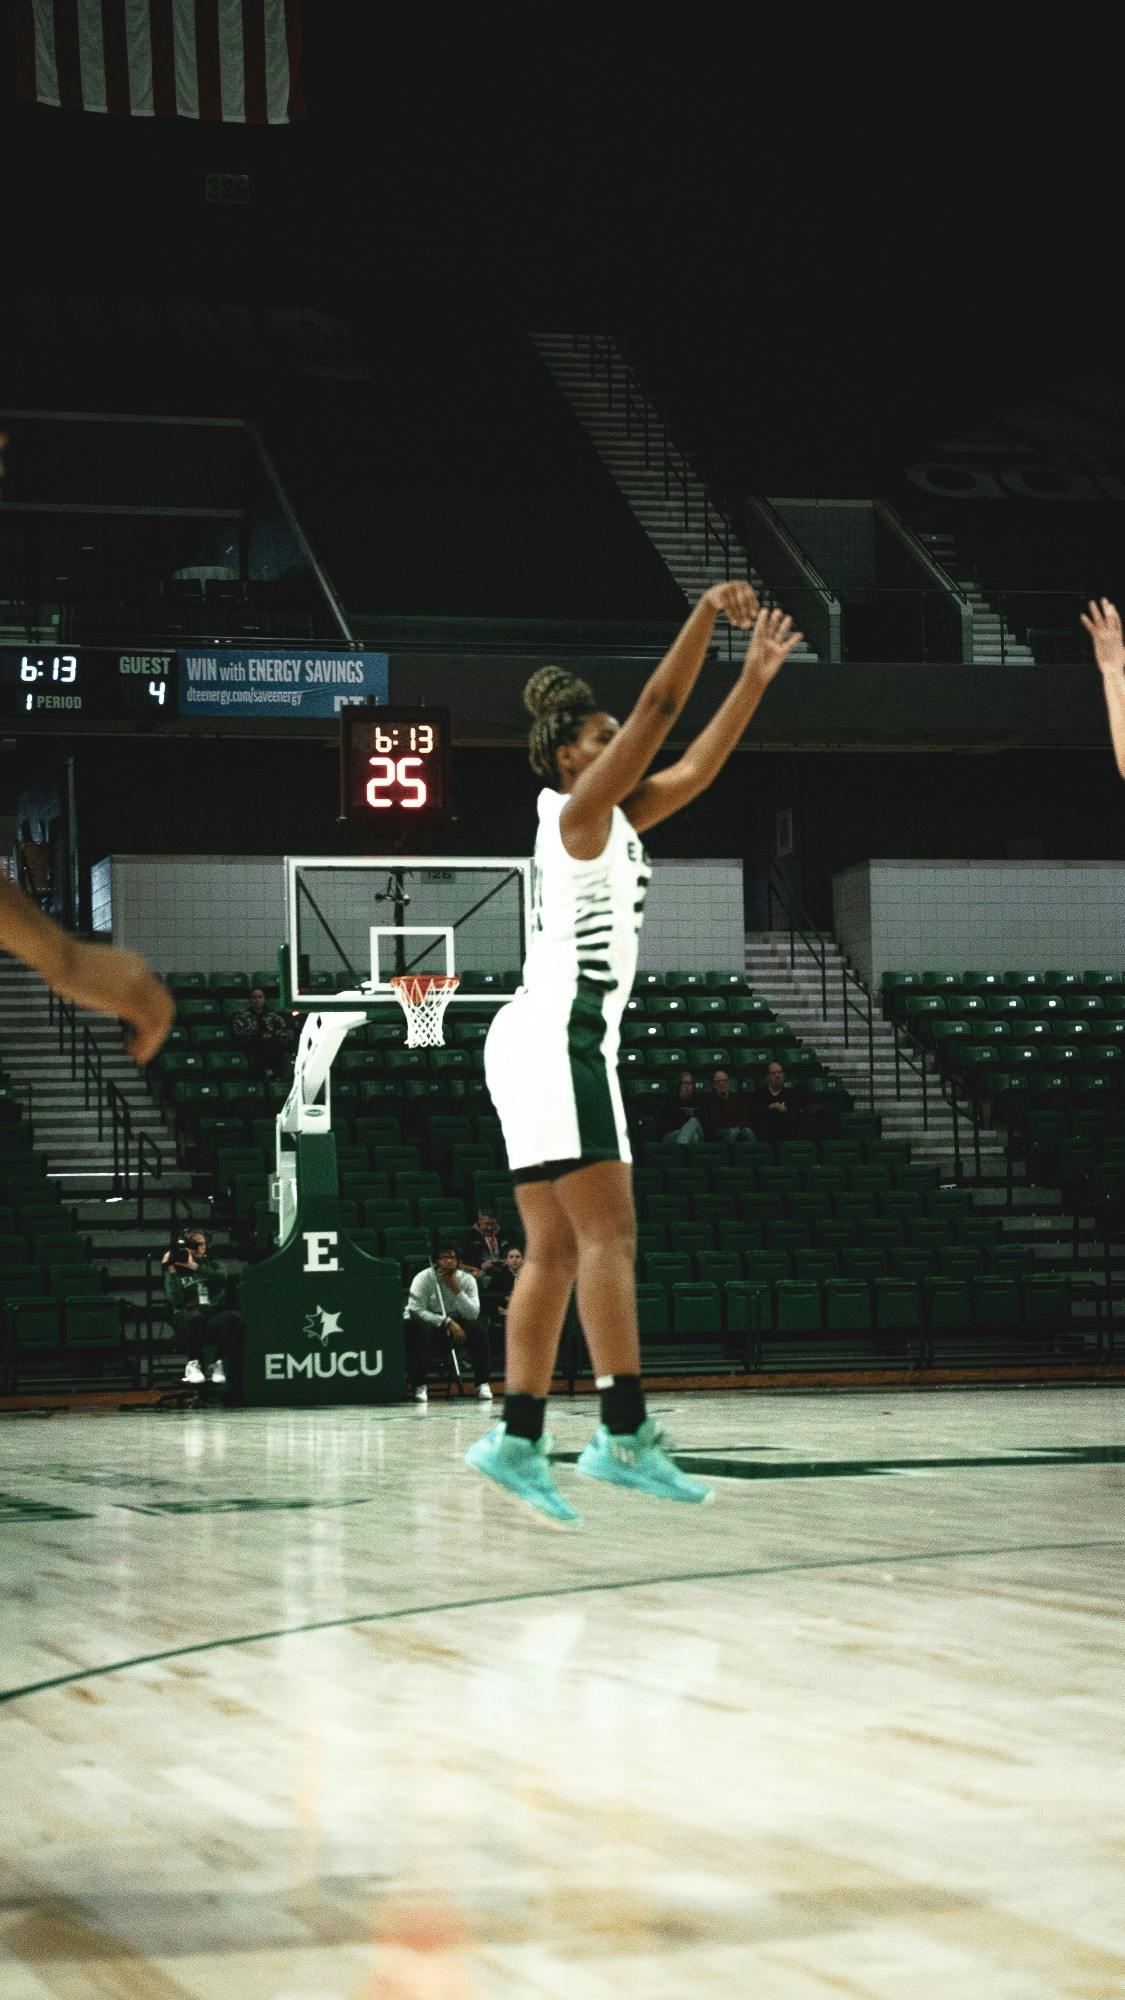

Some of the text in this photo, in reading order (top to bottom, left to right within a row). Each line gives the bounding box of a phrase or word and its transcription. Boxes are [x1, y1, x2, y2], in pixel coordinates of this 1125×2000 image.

[20, 656, 77, 682] 6:13
[119, 656, 171, 674] GUEST
[186, 658, 364, 683] WIN with ENERGY SAVINGS
[26, 693, 82, 711] 1 PERIOD
[148, 681, 166, 705] 4
[186, 686, 303, 706] dteenergy.com/saveenergy
[375, 725, 433, 753] 6:13
[366, 757, 427, 807] 25
[302, 1231, 339, 1272] E
[265, 1350, 383, 1380] EMUCU
